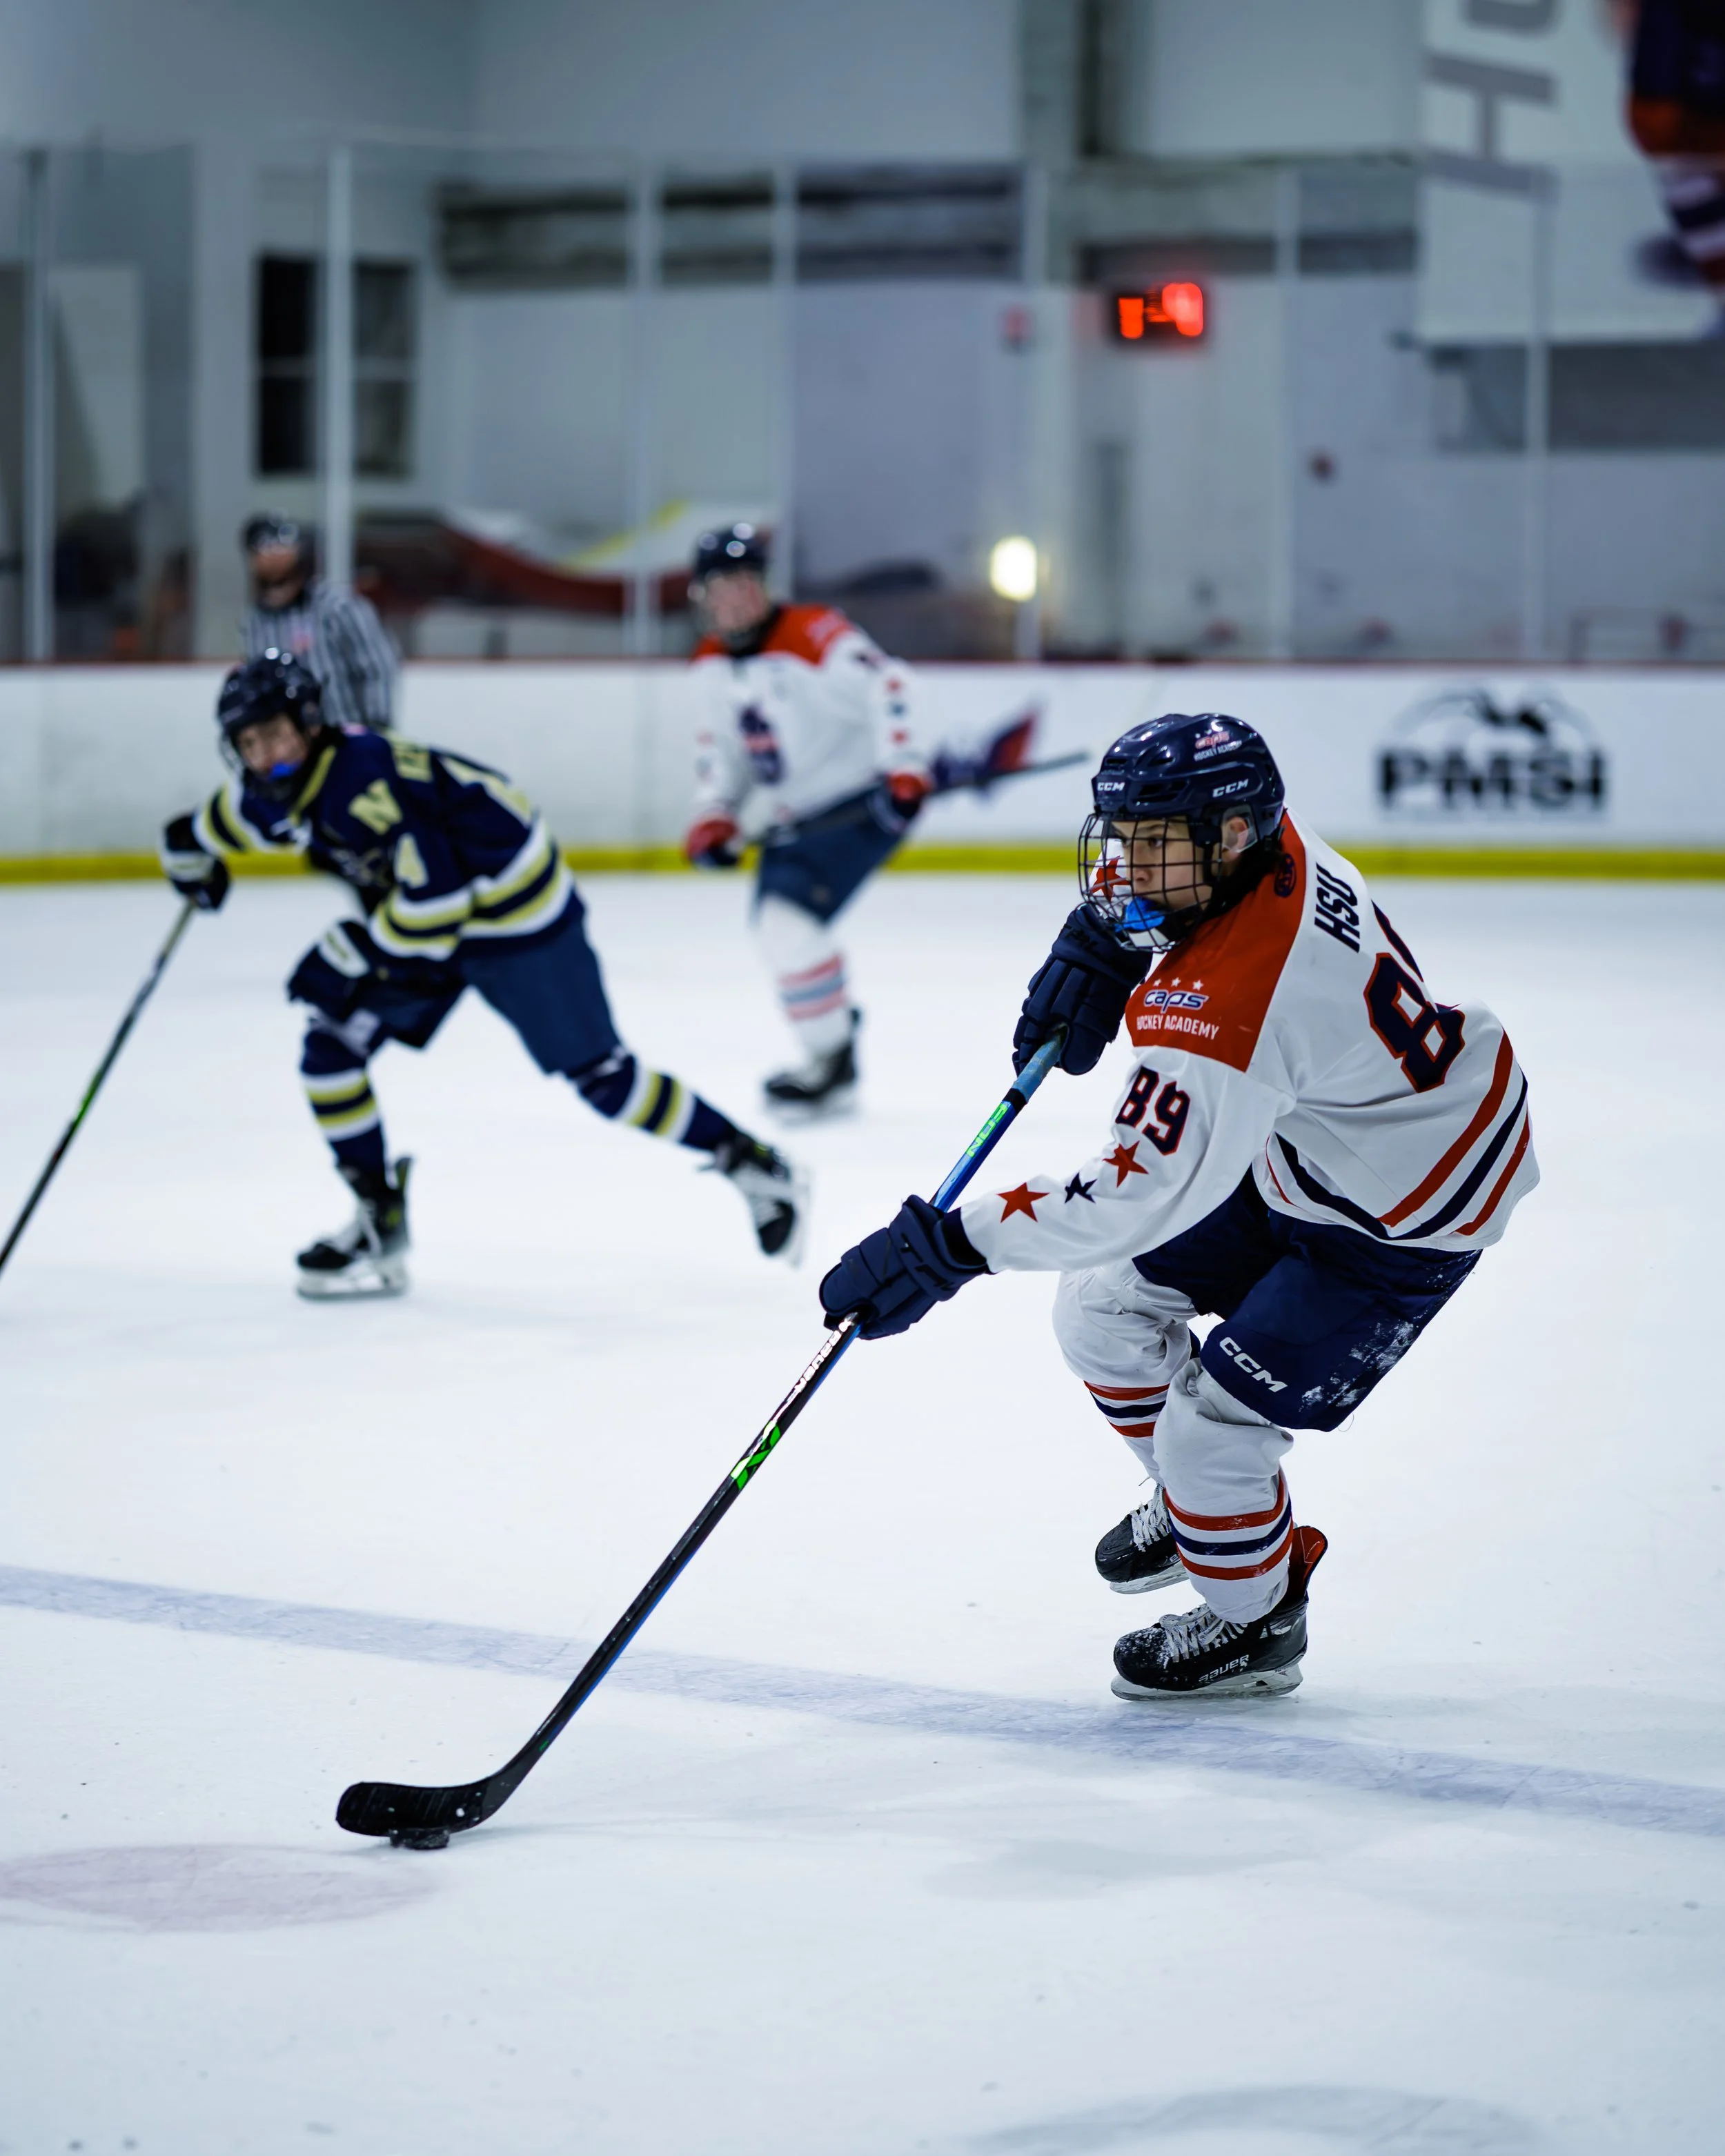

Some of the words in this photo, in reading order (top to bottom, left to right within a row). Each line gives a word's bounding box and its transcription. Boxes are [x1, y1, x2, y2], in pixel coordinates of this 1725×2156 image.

[1097, 782, 1125, 791] CCM
[1212, 779, 1249, 798] CCM
[1314, 861, 1360, 953] HSU
[1143, 989, 1210, 1014] caps
[1363, 899, 1466, 1094] 8
[1136, 1013, 1163, 1030] HOCKEY
[1164, 1015, 1220, 1040] ACADEMY
[1115, 1065, 1190, 1156] 89
[1219, 1336, 1288, 1393] CCM
